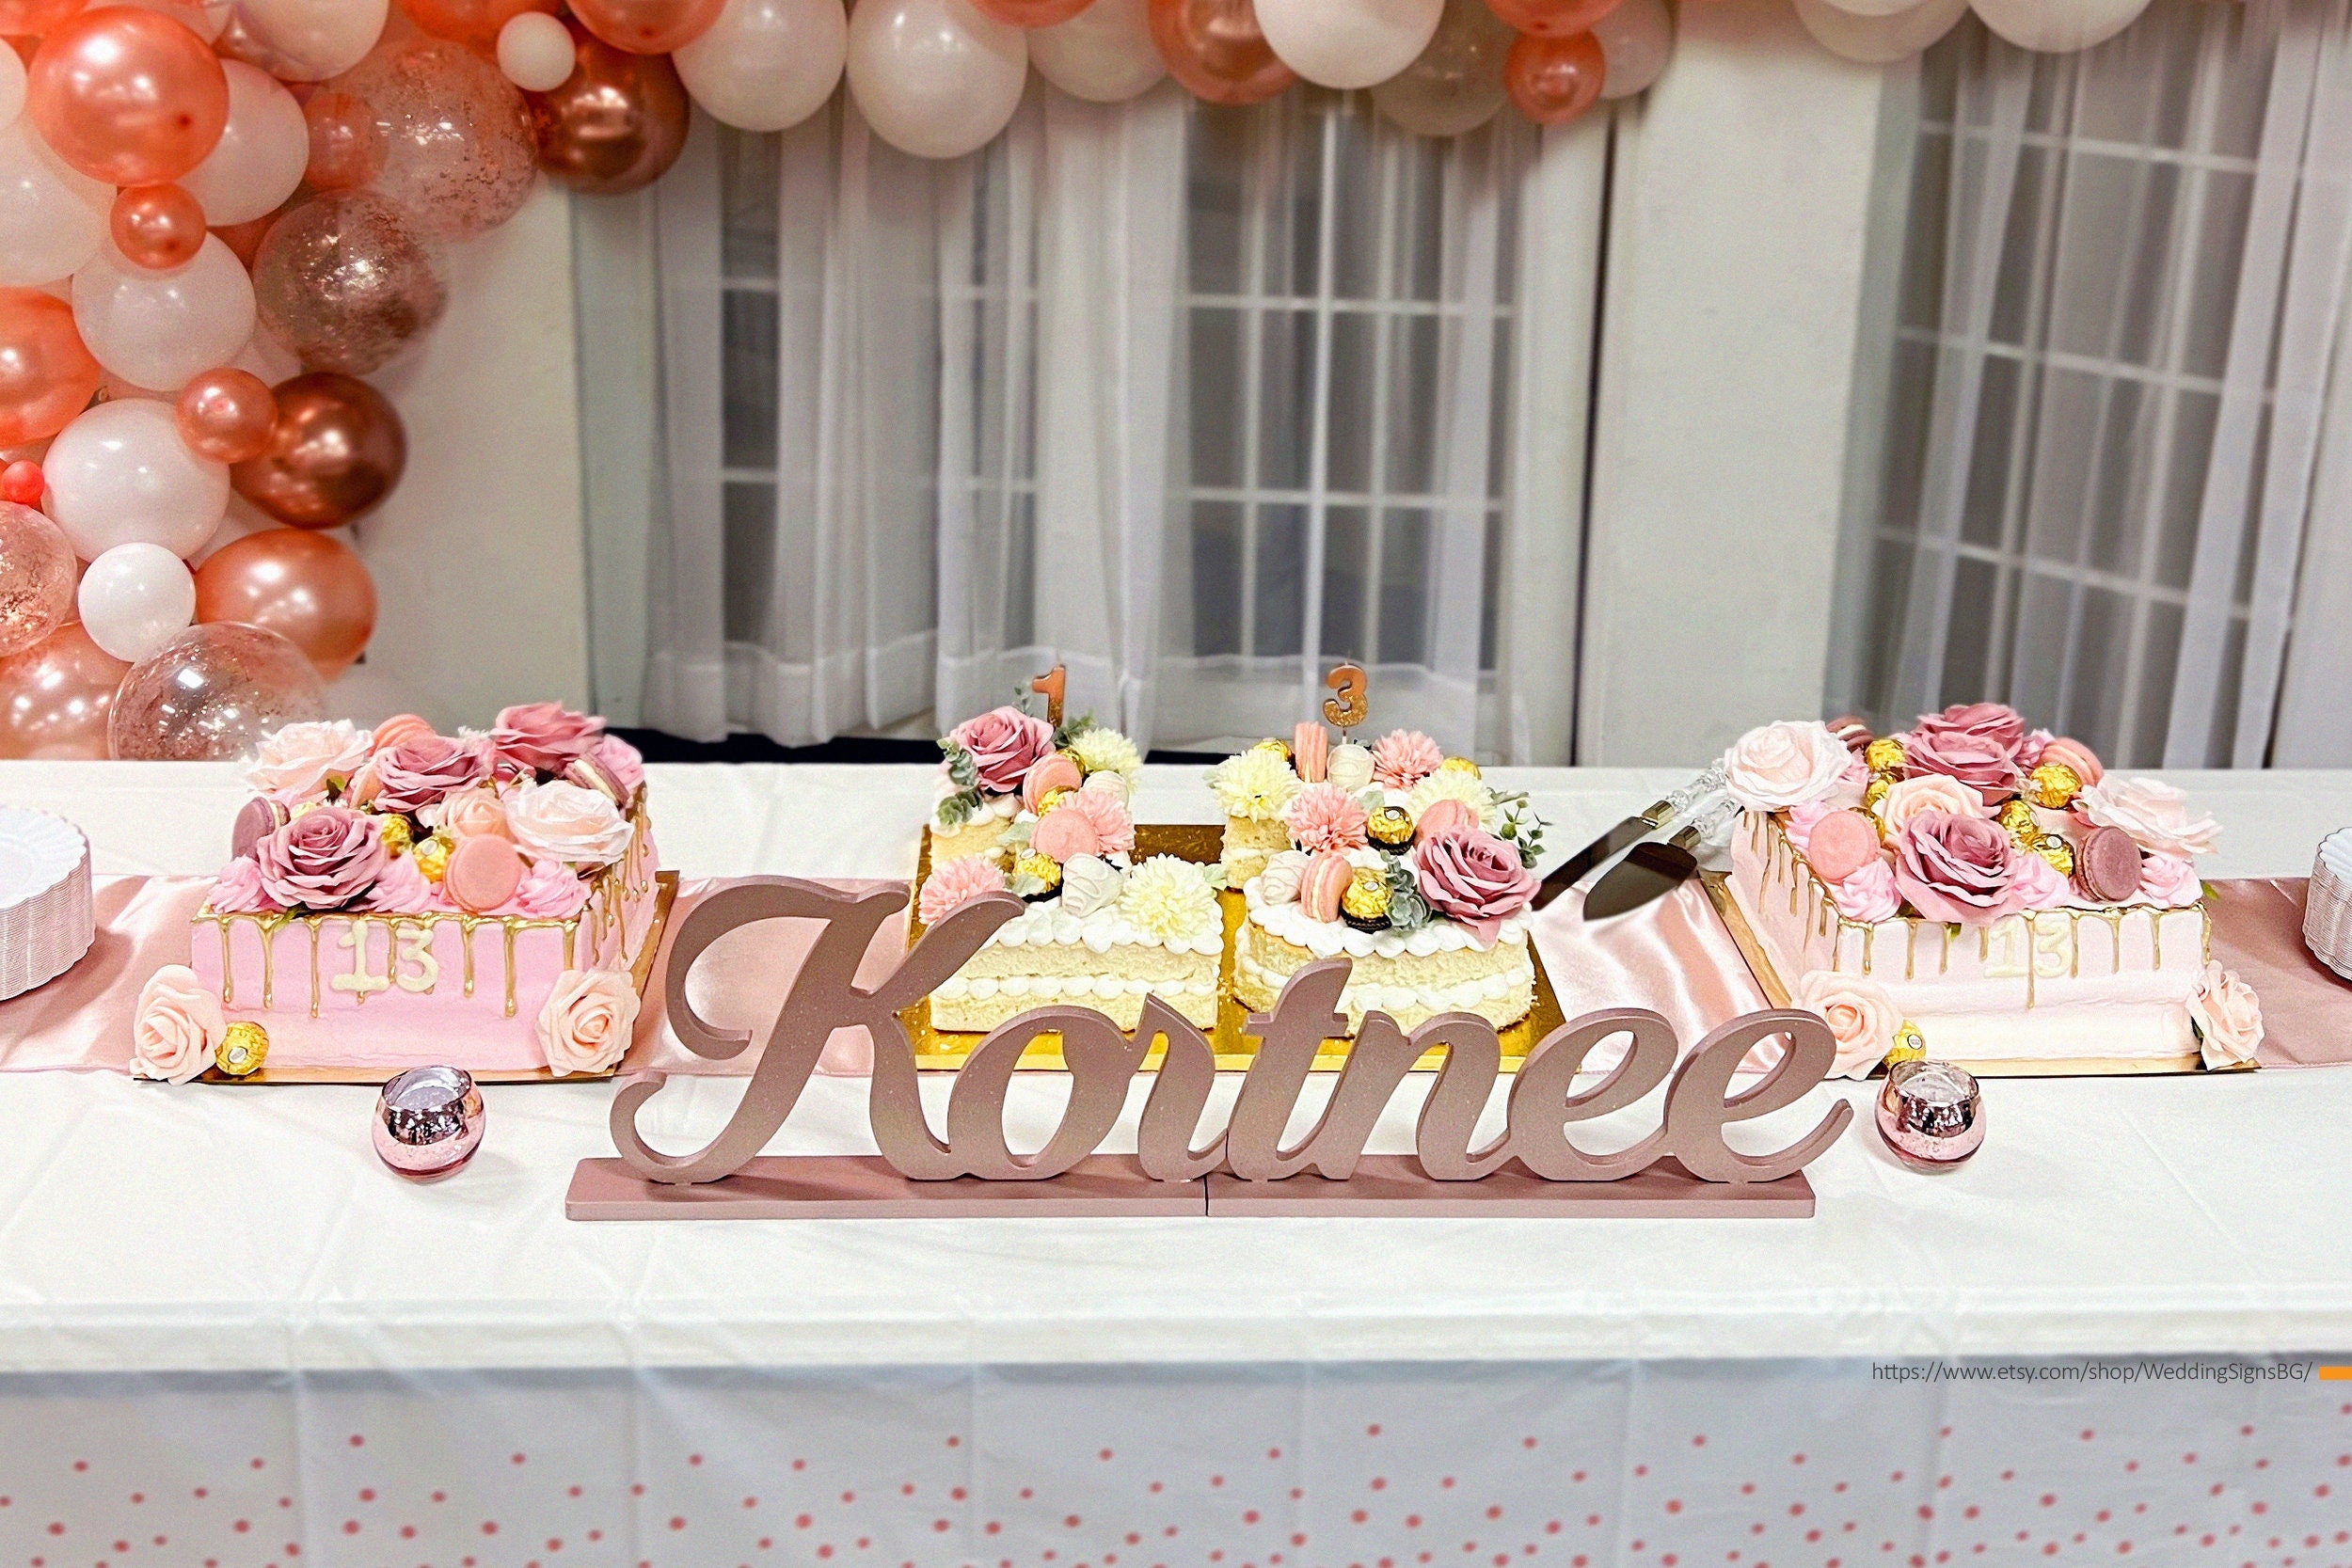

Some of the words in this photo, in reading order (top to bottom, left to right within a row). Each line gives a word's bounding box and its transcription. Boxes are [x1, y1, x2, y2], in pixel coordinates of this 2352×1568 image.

[1033, 664, 1066, 726] 1
[1323, 663, 1368, 726] 3
[332, 920, 438, 991] 13
[1984, 918, 2072, 977] 13
[610, 876, 1851, 1184] Kortnee
